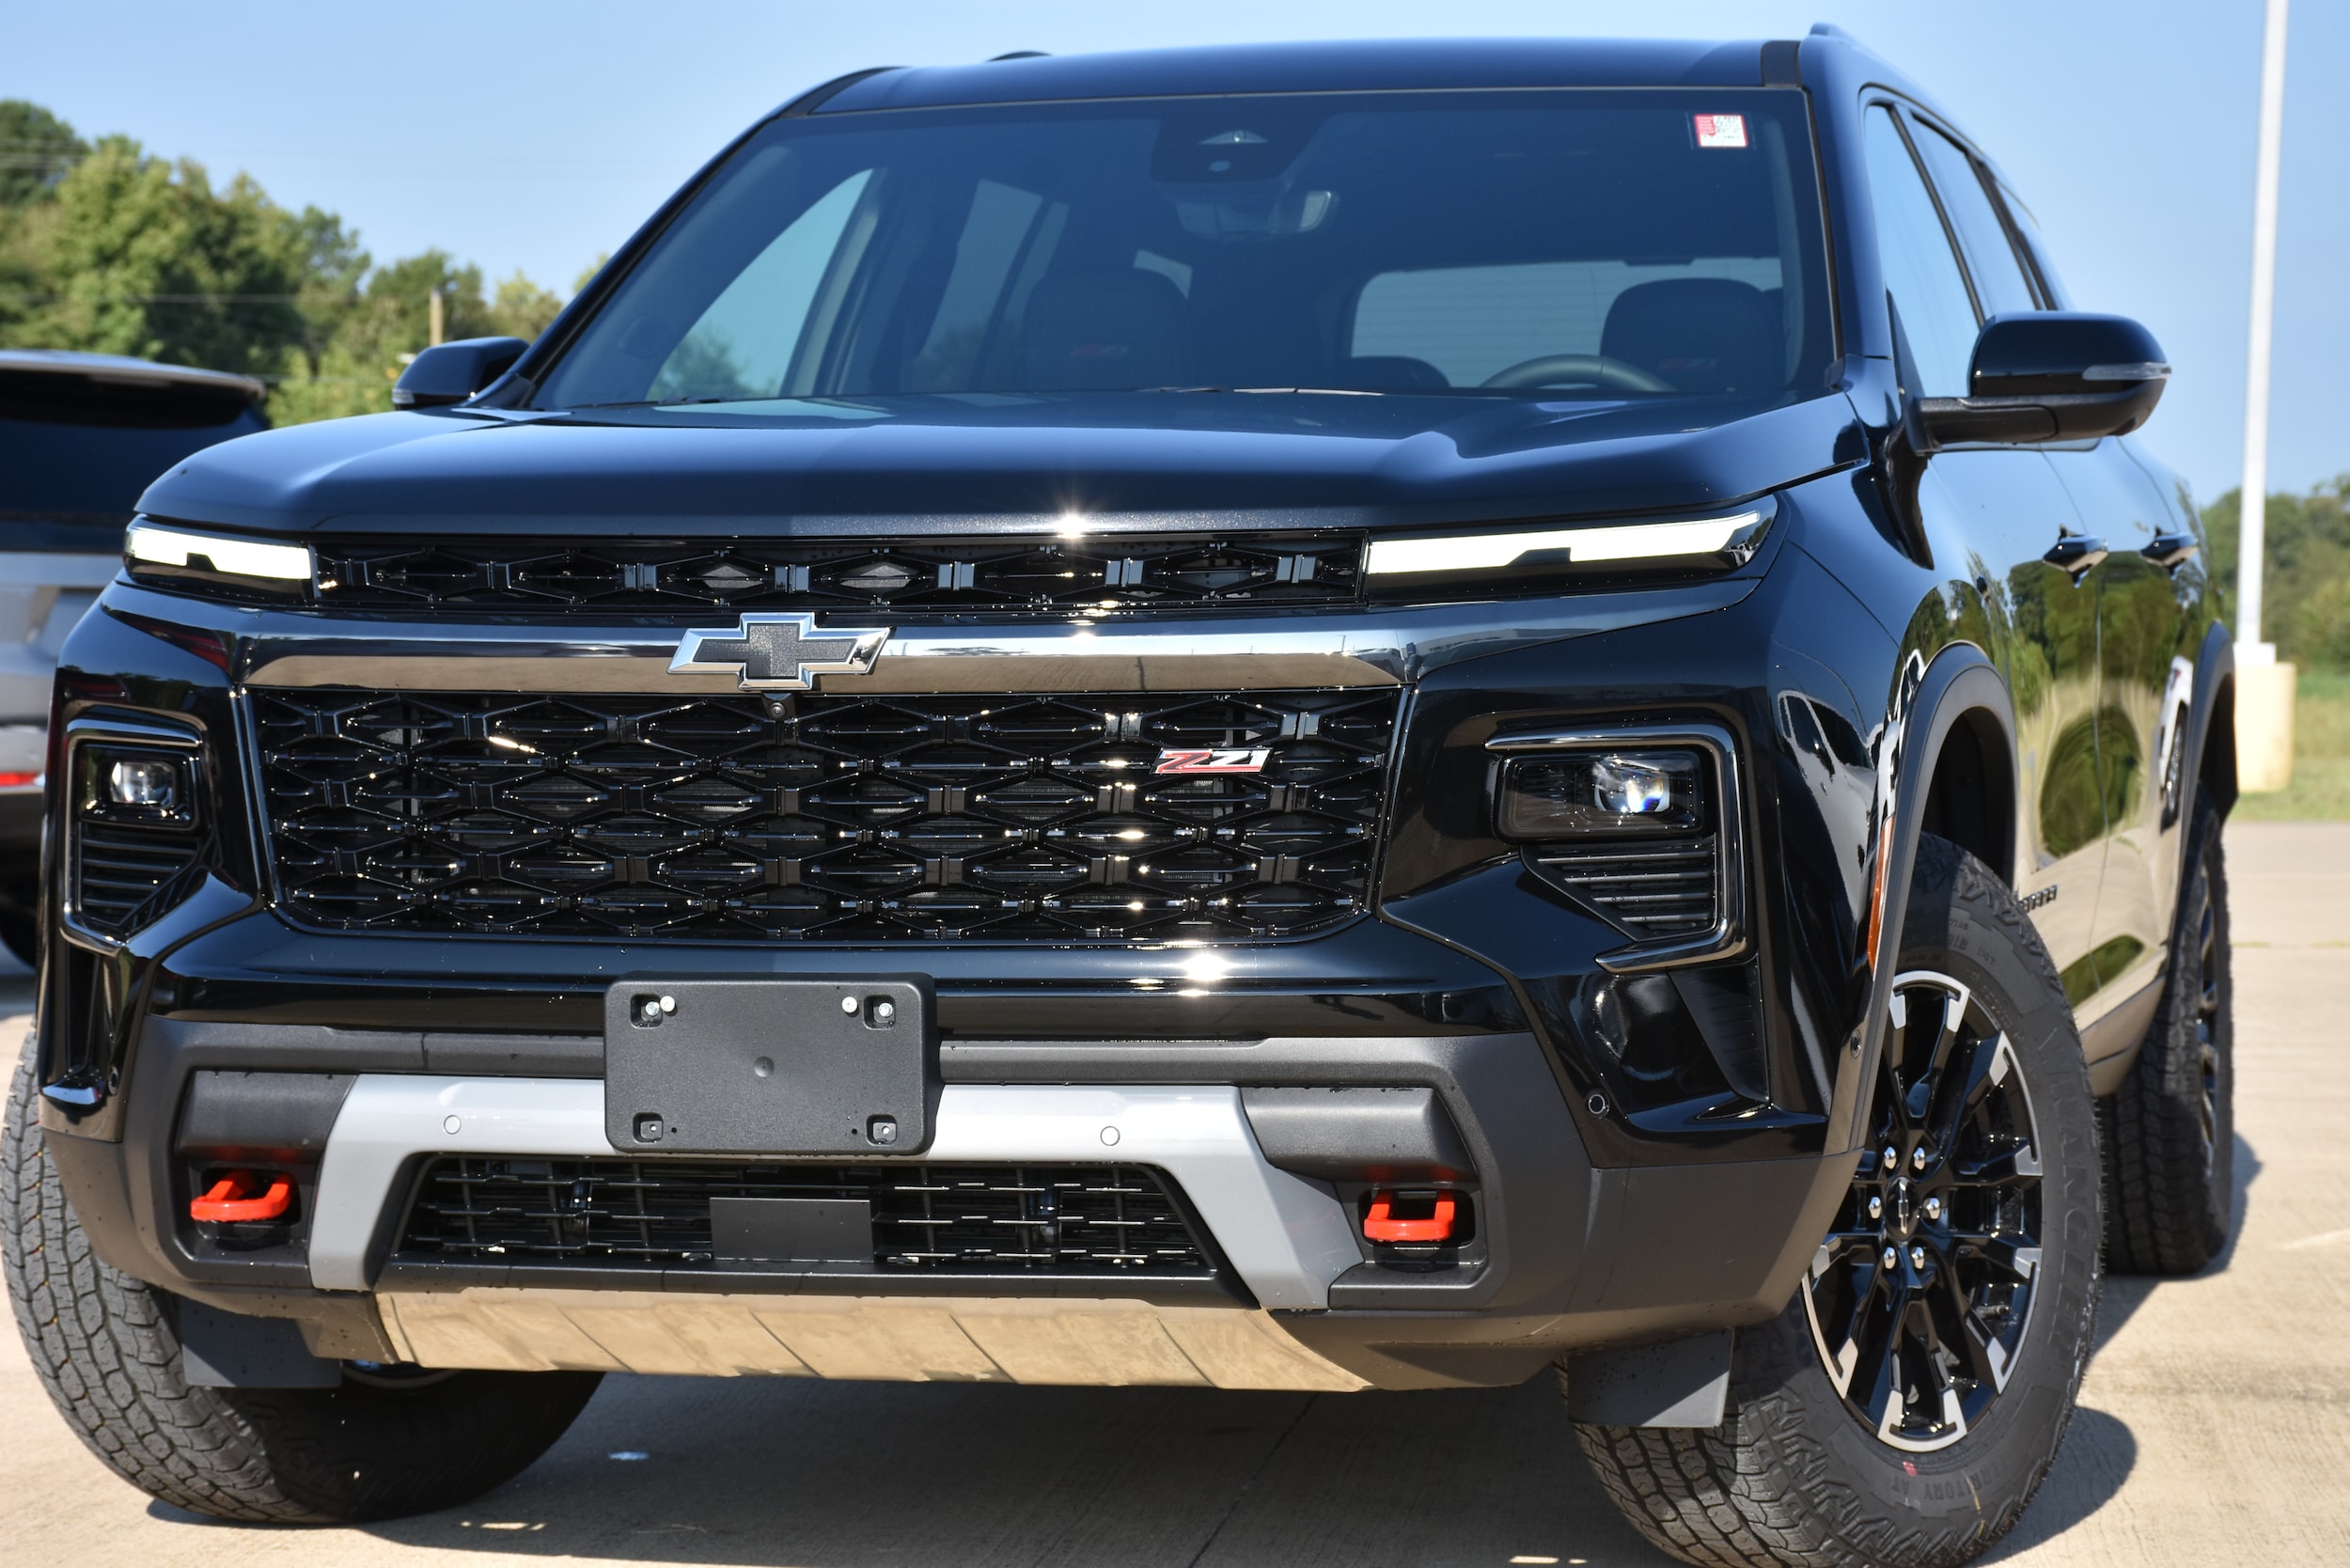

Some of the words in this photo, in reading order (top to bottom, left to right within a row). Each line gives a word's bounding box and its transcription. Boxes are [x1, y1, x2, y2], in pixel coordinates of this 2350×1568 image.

[1152, 747, 1273, 775] Z71
[2038, 1026, 2090, 1356] WRANGLER
[1891, 1475, 1911, 1496] AT
